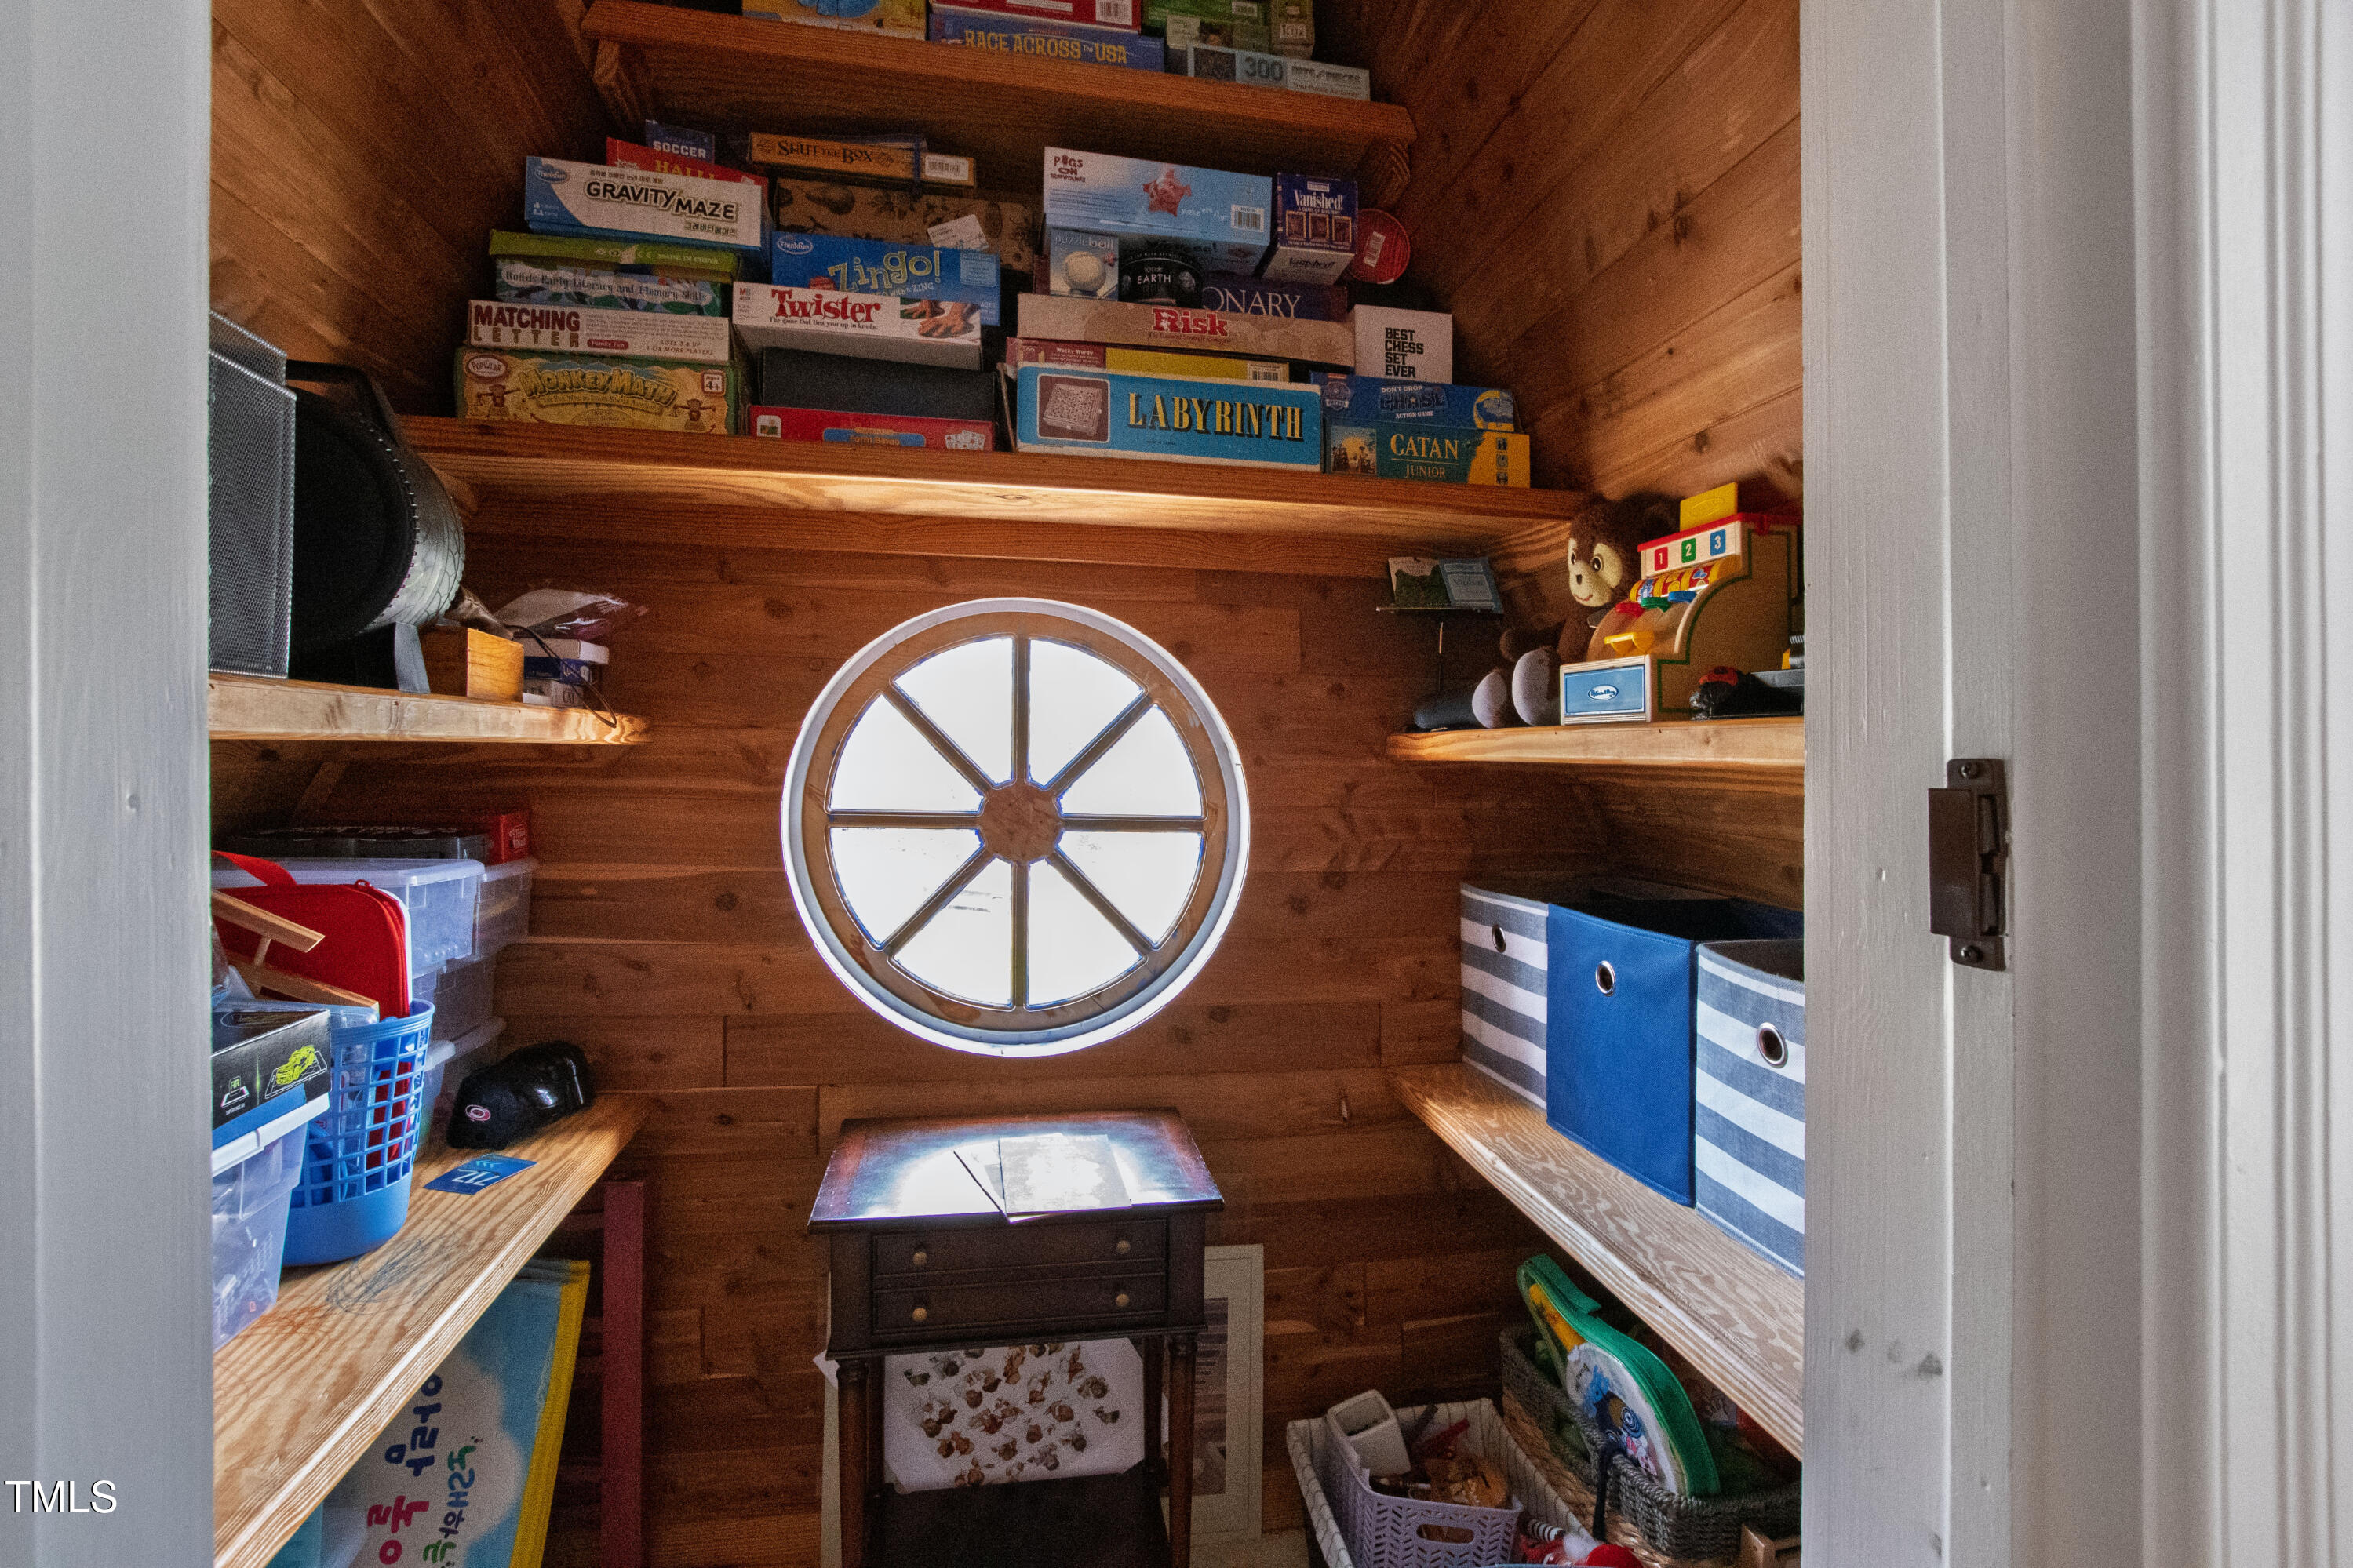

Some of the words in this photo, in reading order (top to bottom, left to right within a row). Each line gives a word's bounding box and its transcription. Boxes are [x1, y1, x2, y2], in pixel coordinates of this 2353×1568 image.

[964, 31, 1008, 52] RACE
[1012, 35, 1081, 60] ACROSS
[1083, 44, 1093, 53] The
[1095, 43, 1127, 64] USA
[1244, 56, 1283, 81] 300
[653, 140, 706, 158] SOCCER
[842, 148, 873, 164] BOX
[587, 181, 677, 208] GRAVITY
[675, 198, 735, 220] MAZE
[1295, 189, 1343, 211] Vanished!
[827, 250, 941, 291] Zingo!
[1290, 257, 1335, 268] Vanished!
[506, 271, 537, 283] Builds
[541, 275, 569, 288] Early
[574, 277, 613, 293] Literacy
[617, 285, 634, 293] and
[639, 286, 678, 300] Memory
[682, 291, 708, 302] Skills
[1137, 275, 1171, 285] EARTH
[771, 289, 882, 322] Twister
[475, 305, 580, 331] MATCHING
[1153, 308, 1228, 337] Risk
[474, 326, 579, 347] LETTER
[1386, 327, 1415, 342] BEST
[1386, 340, 1424, 355] CHESS
[1386, 353, 1408, 366] SET
[1386, 366, 1415, 378] EVER
[518, 369, 611, 398] MONKEY
[610, 369, 677, 406] MATH
[705, 381, 721, 391] 4+
[1380, 390, 1448, 411] CHASE
[1127, 392, 1304, 442] LABYRINTH
[1390, 434, 1459, 460] CATAN
[1404, 464, 1445, 478] JUNIOR
[1685, 543, 1692, 557] 2
[1714, 535, 1721, 549] 3
[1659, 553, 1663, 565] 1
[230, 1079, 240, 1090] AR
[385, 1374, 443, 1477] 아람
